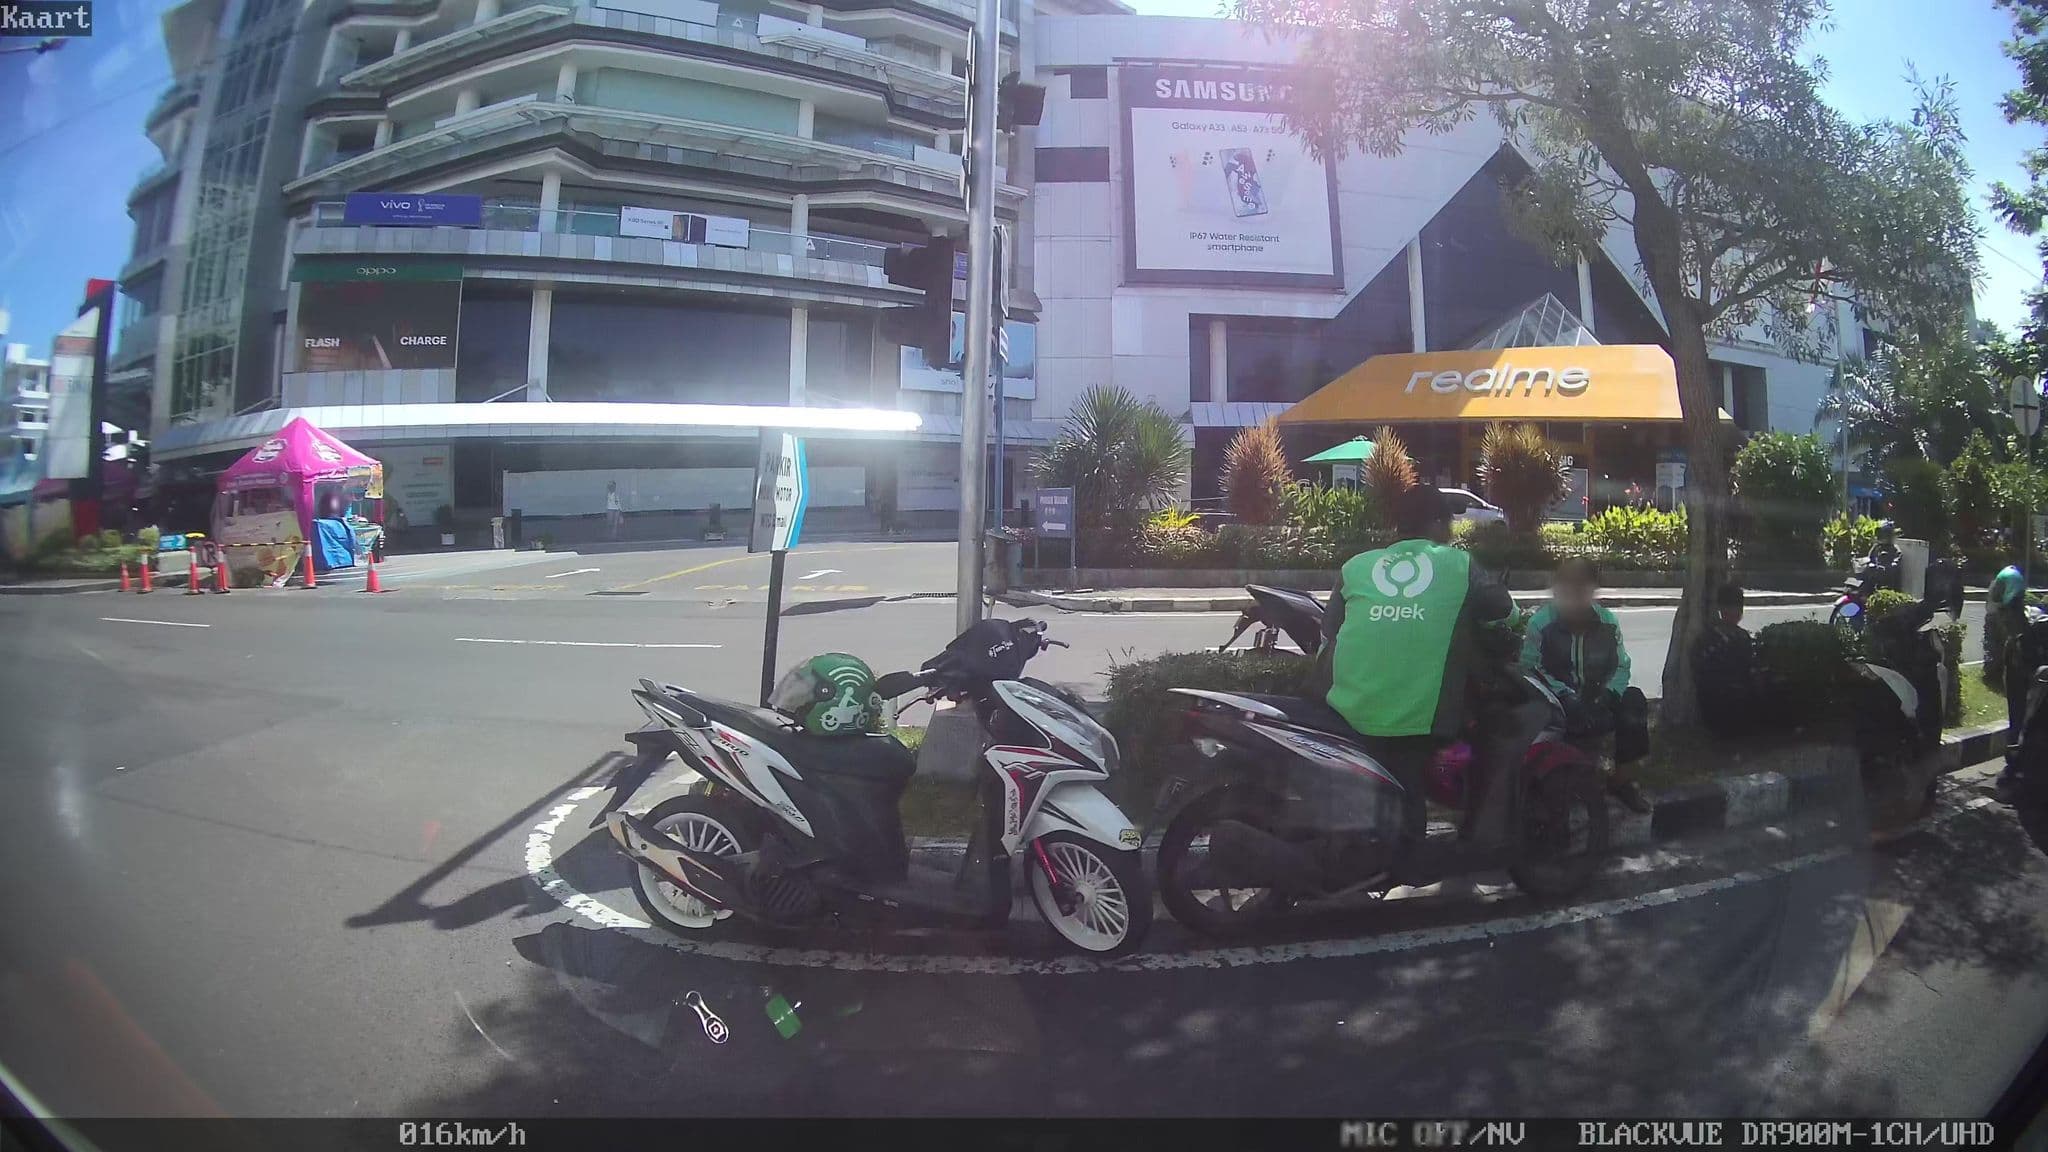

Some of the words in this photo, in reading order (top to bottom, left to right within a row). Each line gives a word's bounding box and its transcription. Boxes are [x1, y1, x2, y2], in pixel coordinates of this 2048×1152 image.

[1171, 121, 1207, 132] Galaxy
[1209, 122, 1226, 132] A33
[380, 199, 411, 209] vivo
[1189, 232, 1208, 240] IP67
[1209, 232, 1237, 241] Water
[1239, 233, 1280, 243] Resistant
[1207, 244, 1264, 253] smartphone
[304, 337, 341, 348] FLASH
[400, 336, 447, 346] CHARGE
[1404, 362, 1590, 396] realme
[1369, 603, 1425, 621] gojek
